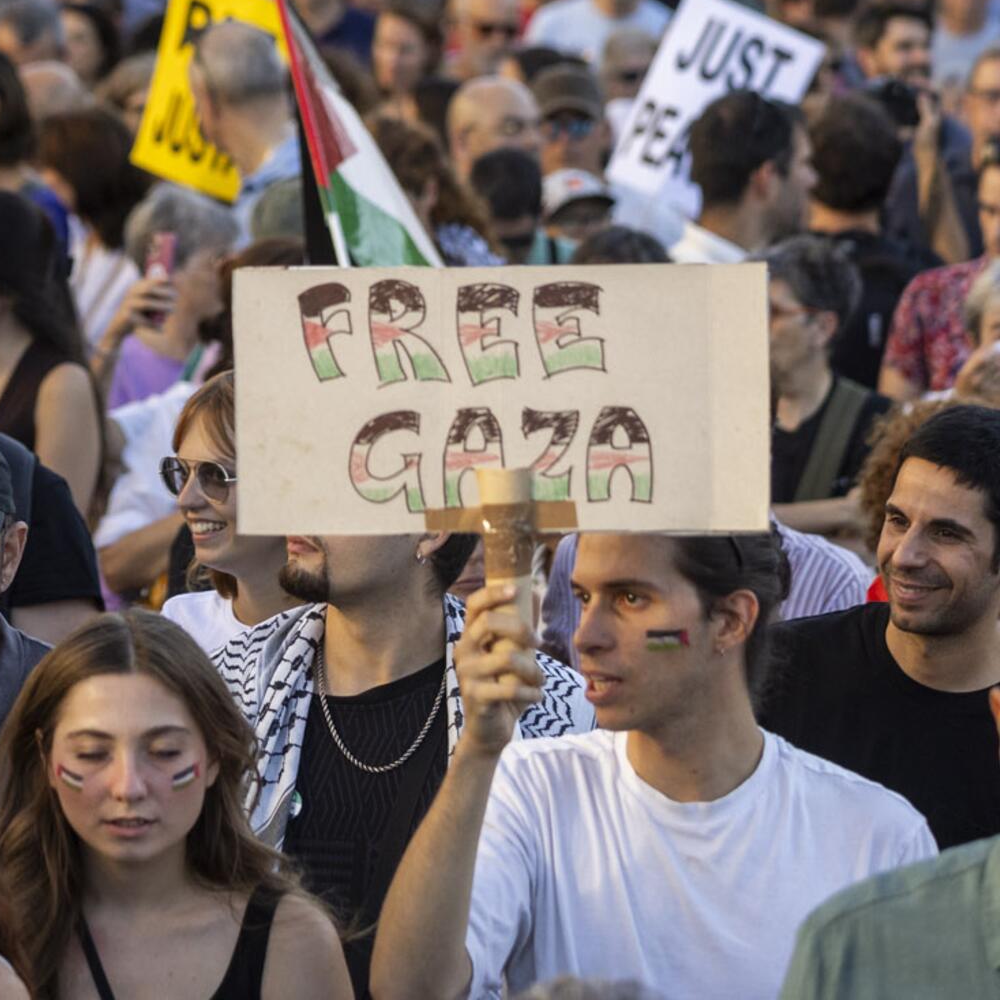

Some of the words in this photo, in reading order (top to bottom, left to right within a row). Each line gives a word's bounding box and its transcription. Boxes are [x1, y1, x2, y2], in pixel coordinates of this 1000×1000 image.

[674, 14, 795, 95] JUST
[619, 100, 690, 180] PEA
[297, 278, 608, 389] FREE
[348, 405, 654, 513] GAZA
